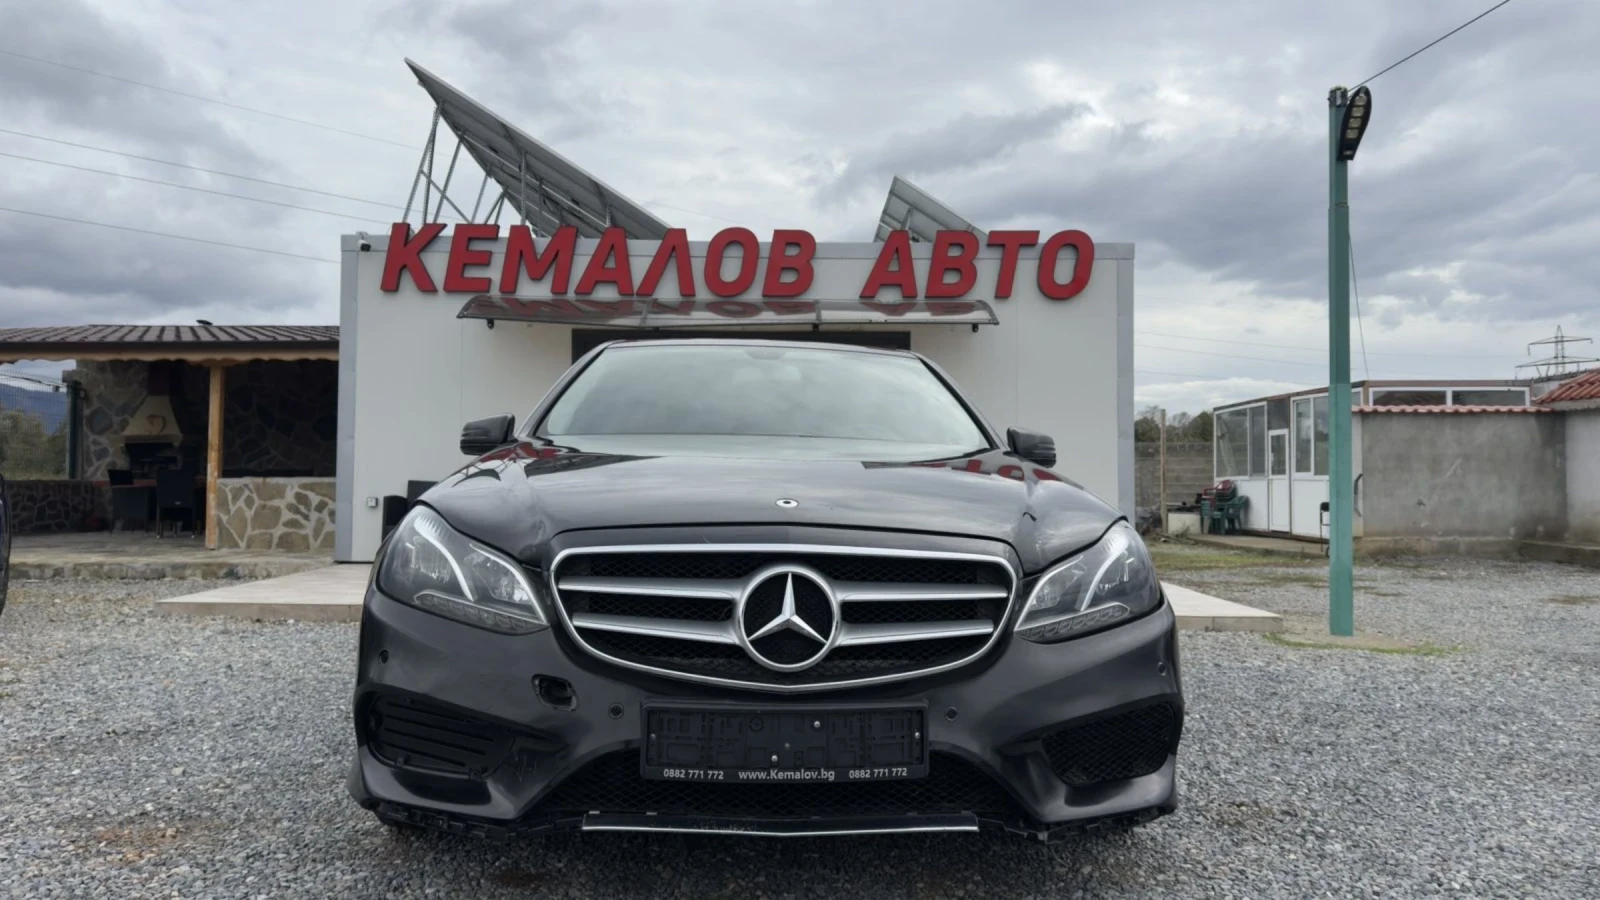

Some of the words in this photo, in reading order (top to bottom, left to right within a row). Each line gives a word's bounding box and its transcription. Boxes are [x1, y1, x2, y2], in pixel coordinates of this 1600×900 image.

[380, 222, 817, 298] КЕМАЛОВ
[859, 229, 1095, 300] АВТО
[663, 768, 686, 778] 0882
[688, 769, 705, 779] 771
[707, 770, 724, 780] 772
[738, 769, 835, 781] www.Kemalov.bg
[848, 769, 871, 779] 0882
[873, 768, 889, 777] 771
[891, 767, 908, 776] 772
